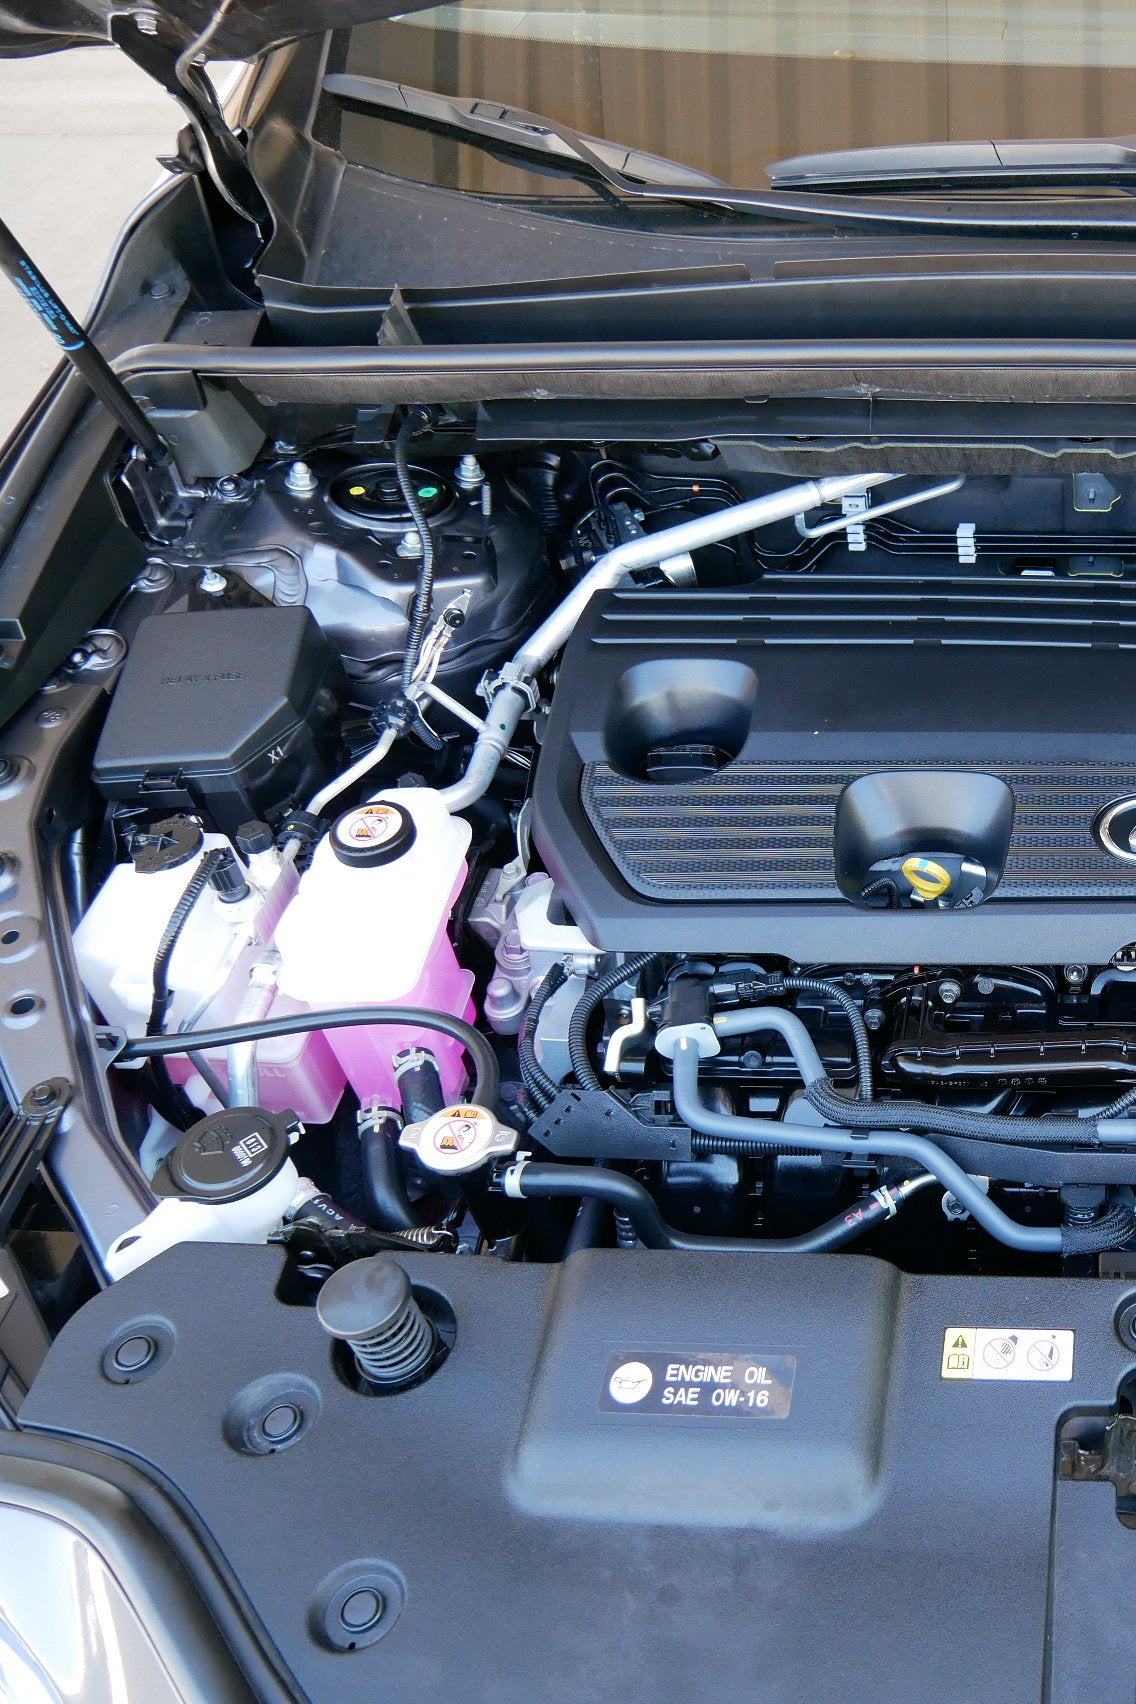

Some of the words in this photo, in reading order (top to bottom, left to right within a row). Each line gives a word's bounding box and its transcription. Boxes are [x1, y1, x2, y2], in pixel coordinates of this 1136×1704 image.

[665, 1364, 734, 1383] ENGINE
[744, 1366, 773, 1385] OIL
[661, 1386, 701, 1406] SAE
